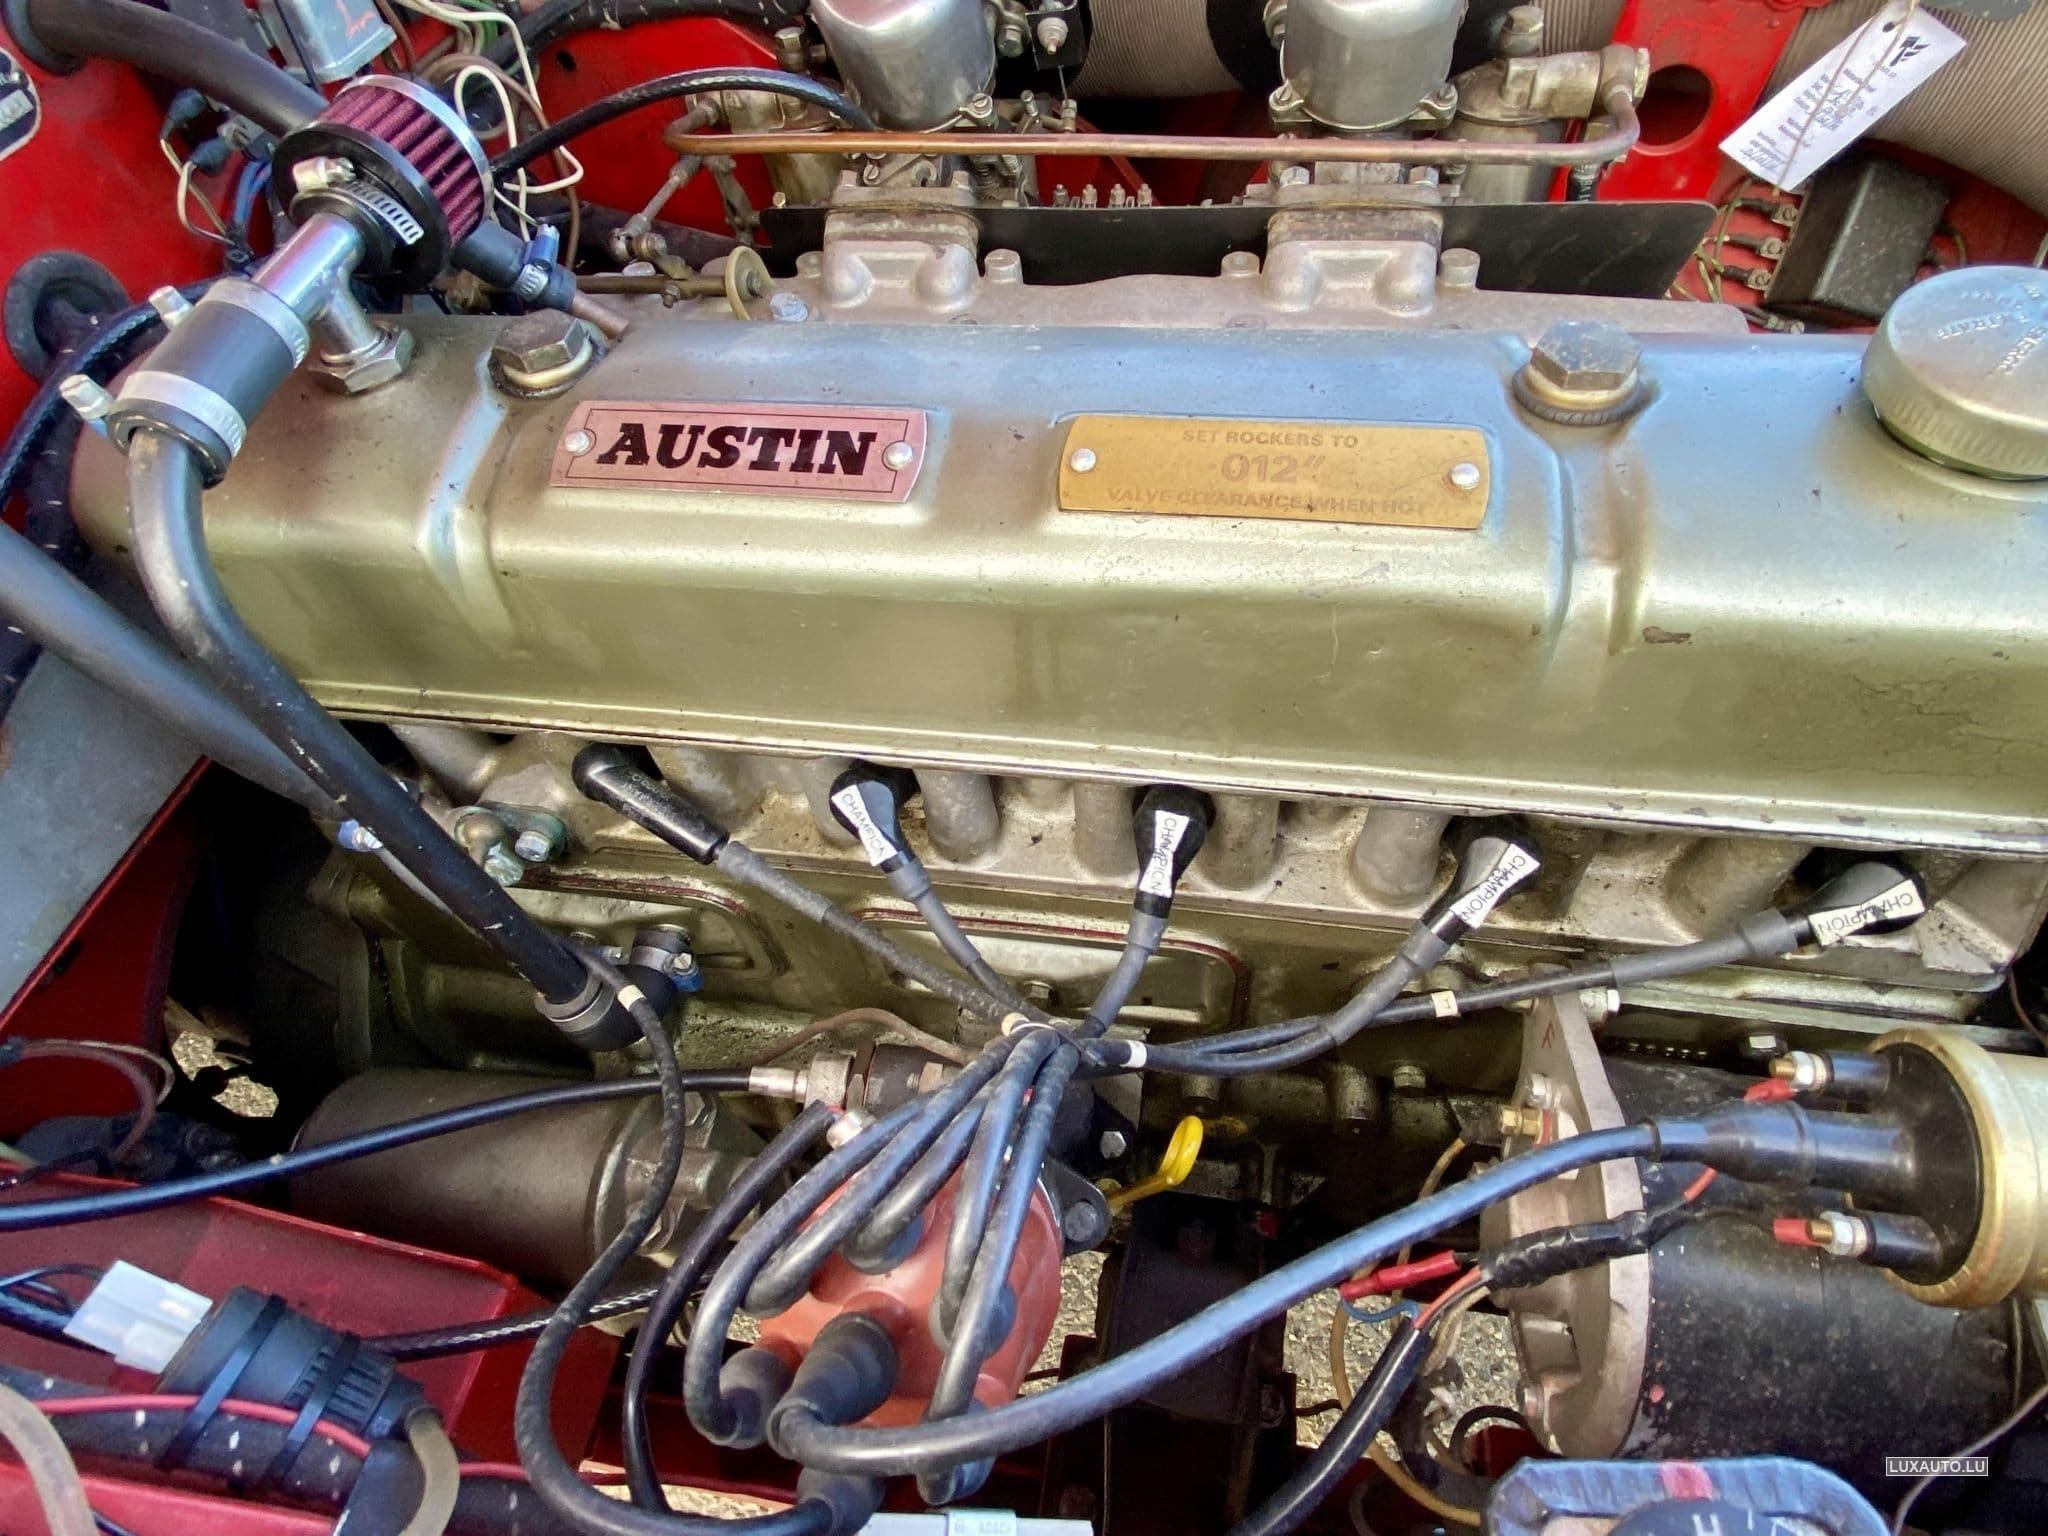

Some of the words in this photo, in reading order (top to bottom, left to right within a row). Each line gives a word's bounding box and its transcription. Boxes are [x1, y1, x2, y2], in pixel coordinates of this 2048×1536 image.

[596, 422, 878, 476] AUSTIN
[1183, 429, 1217, 443] SET
[1225, 430, 1323, 447] ROCKERS
[1330, 434, 1359, 449] TO
[1107, 487, 1172, 504] VALVE
[1151, 817, 1177, 891] CHAMPION
[1460, 855, 1526, 922] CHAMPION
[1817, 892, 1914, 935] CHAMPION
